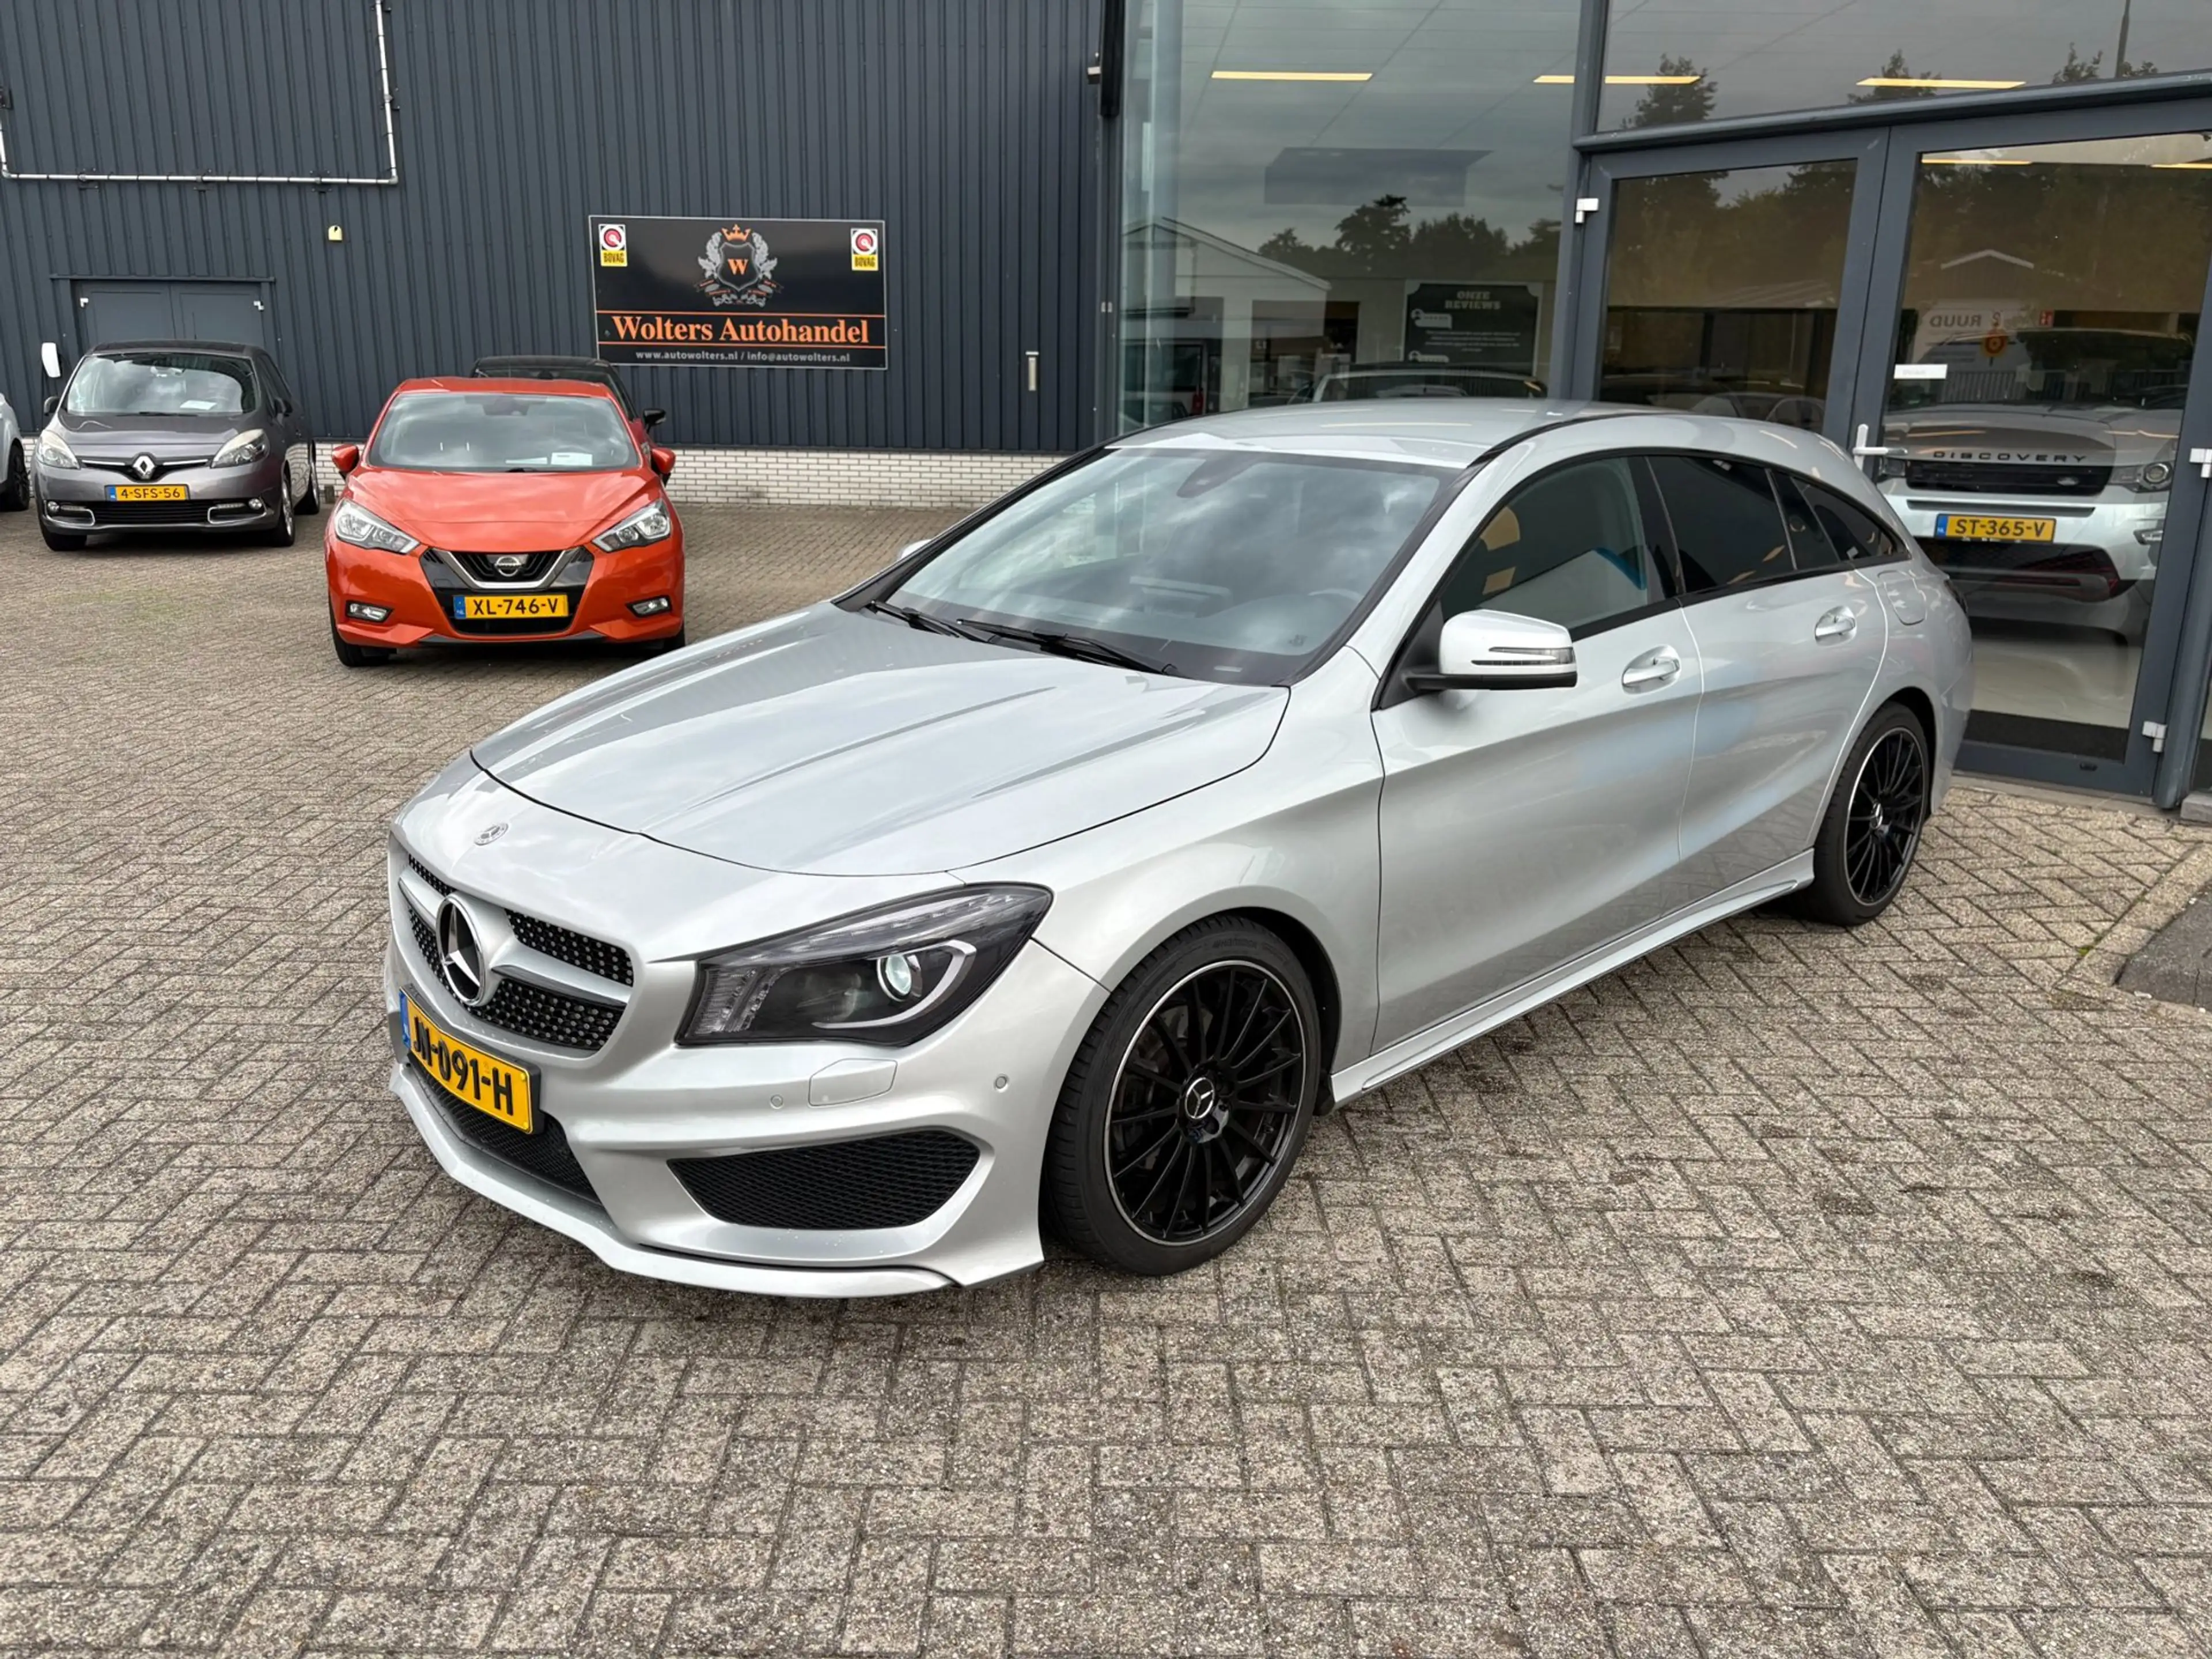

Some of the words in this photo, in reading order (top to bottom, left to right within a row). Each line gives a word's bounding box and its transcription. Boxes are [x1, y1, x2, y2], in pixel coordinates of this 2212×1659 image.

[726, 257, 749, 275] W
[611, 316, 714, 341] Wolters
[718, 317, 869, 344] Autohandel
[635, 350, 738, 361] www.autowolters.nl
[747, 351, 851, 362] info@autowolters.nl
[1933, 450, 2086, 462] DISCOVERY
[120, 487, 181, 499] 4-SFS-56
[1955, 518, 2047, 538] ST-365-V
[473, 597, 558, 616] XL-746-V
[414, 1016, 514, 1117] JN-091-H
